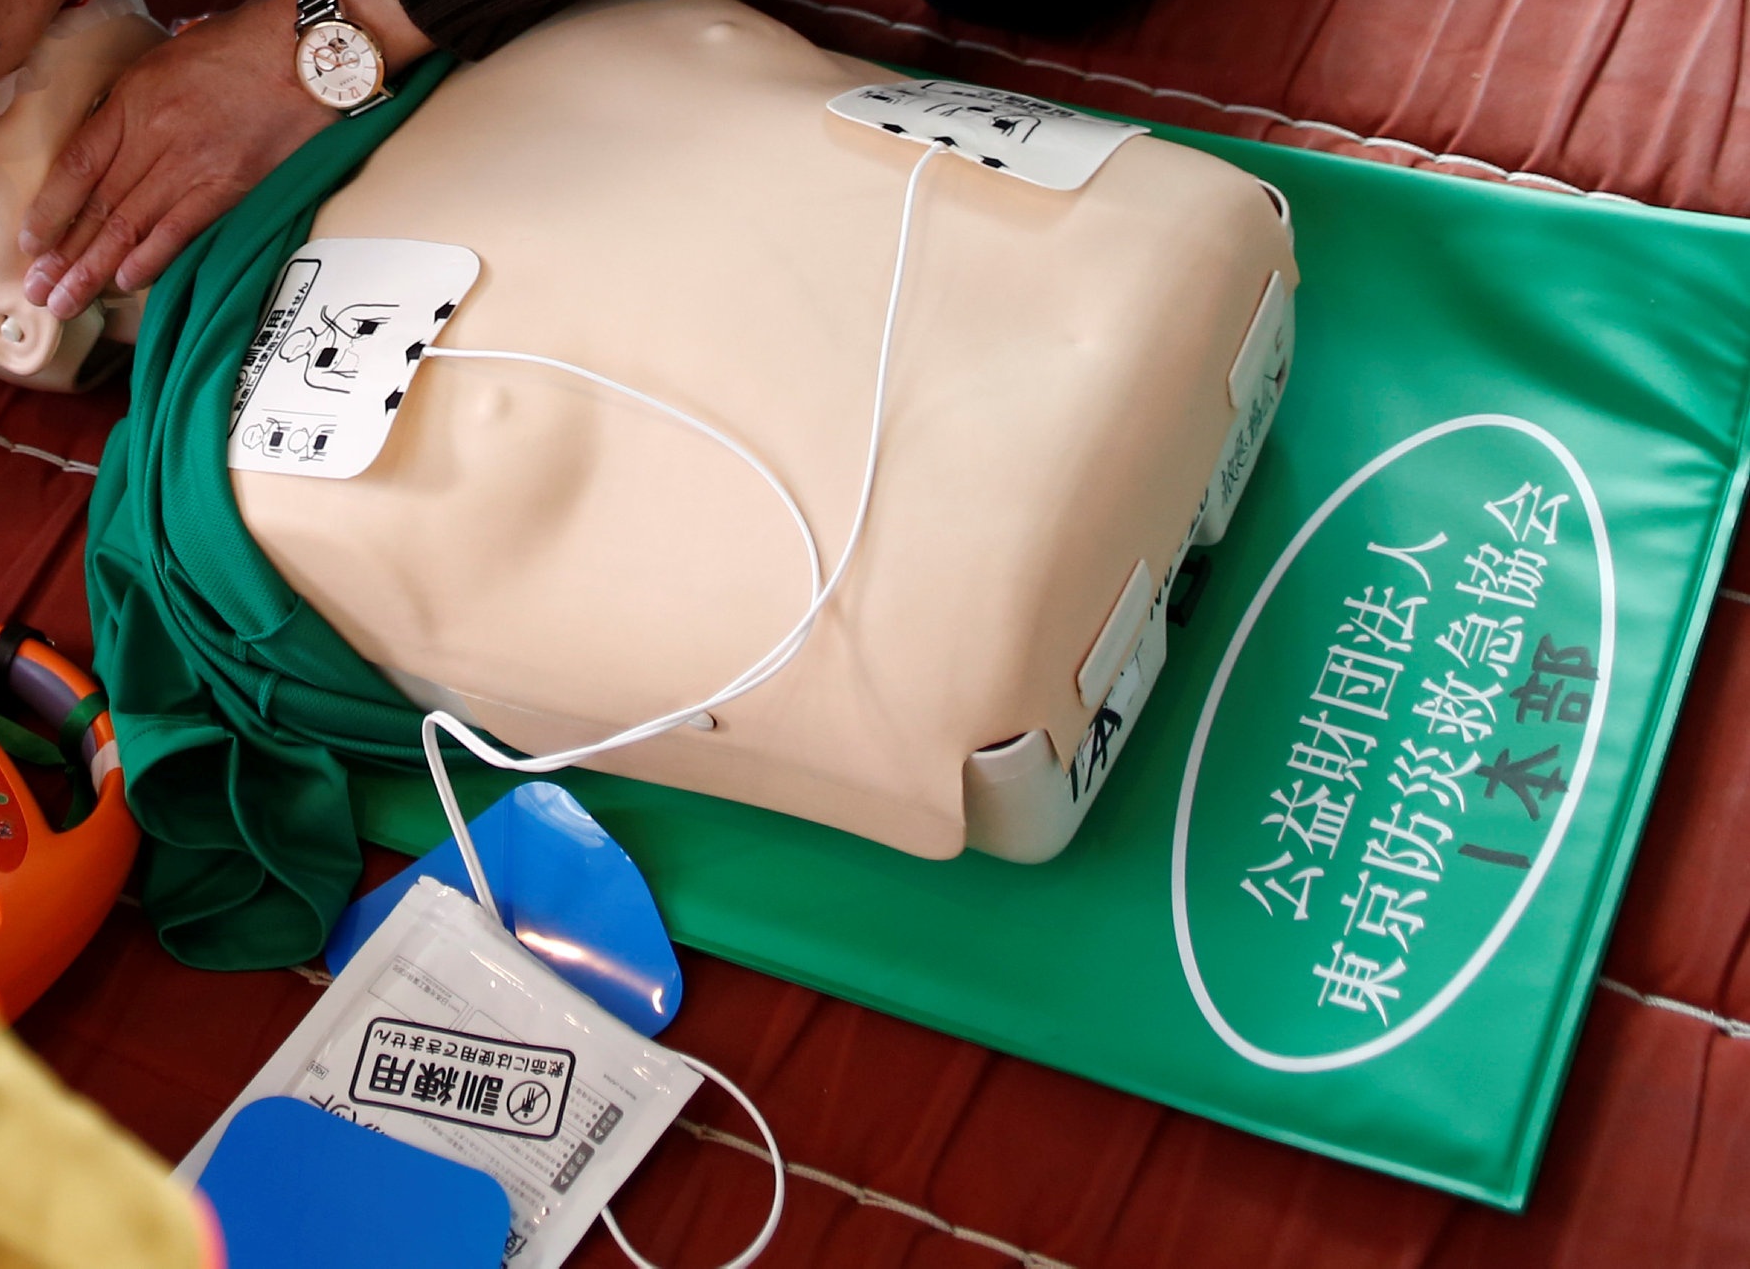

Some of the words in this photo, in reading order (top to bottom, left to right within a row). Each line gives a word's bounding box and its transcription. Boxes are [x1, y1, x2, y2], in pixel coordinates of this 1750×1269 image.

[350, 86, 362, 99] 12
[1239, 531, 1449, 921] 公益財団法人
[1312, 481, 1569, 1028] 東京防災救急協会
[368, 1053, 505, 1118] 訓練用
[373, 1029, 565, 1079] 救命には使用できません
